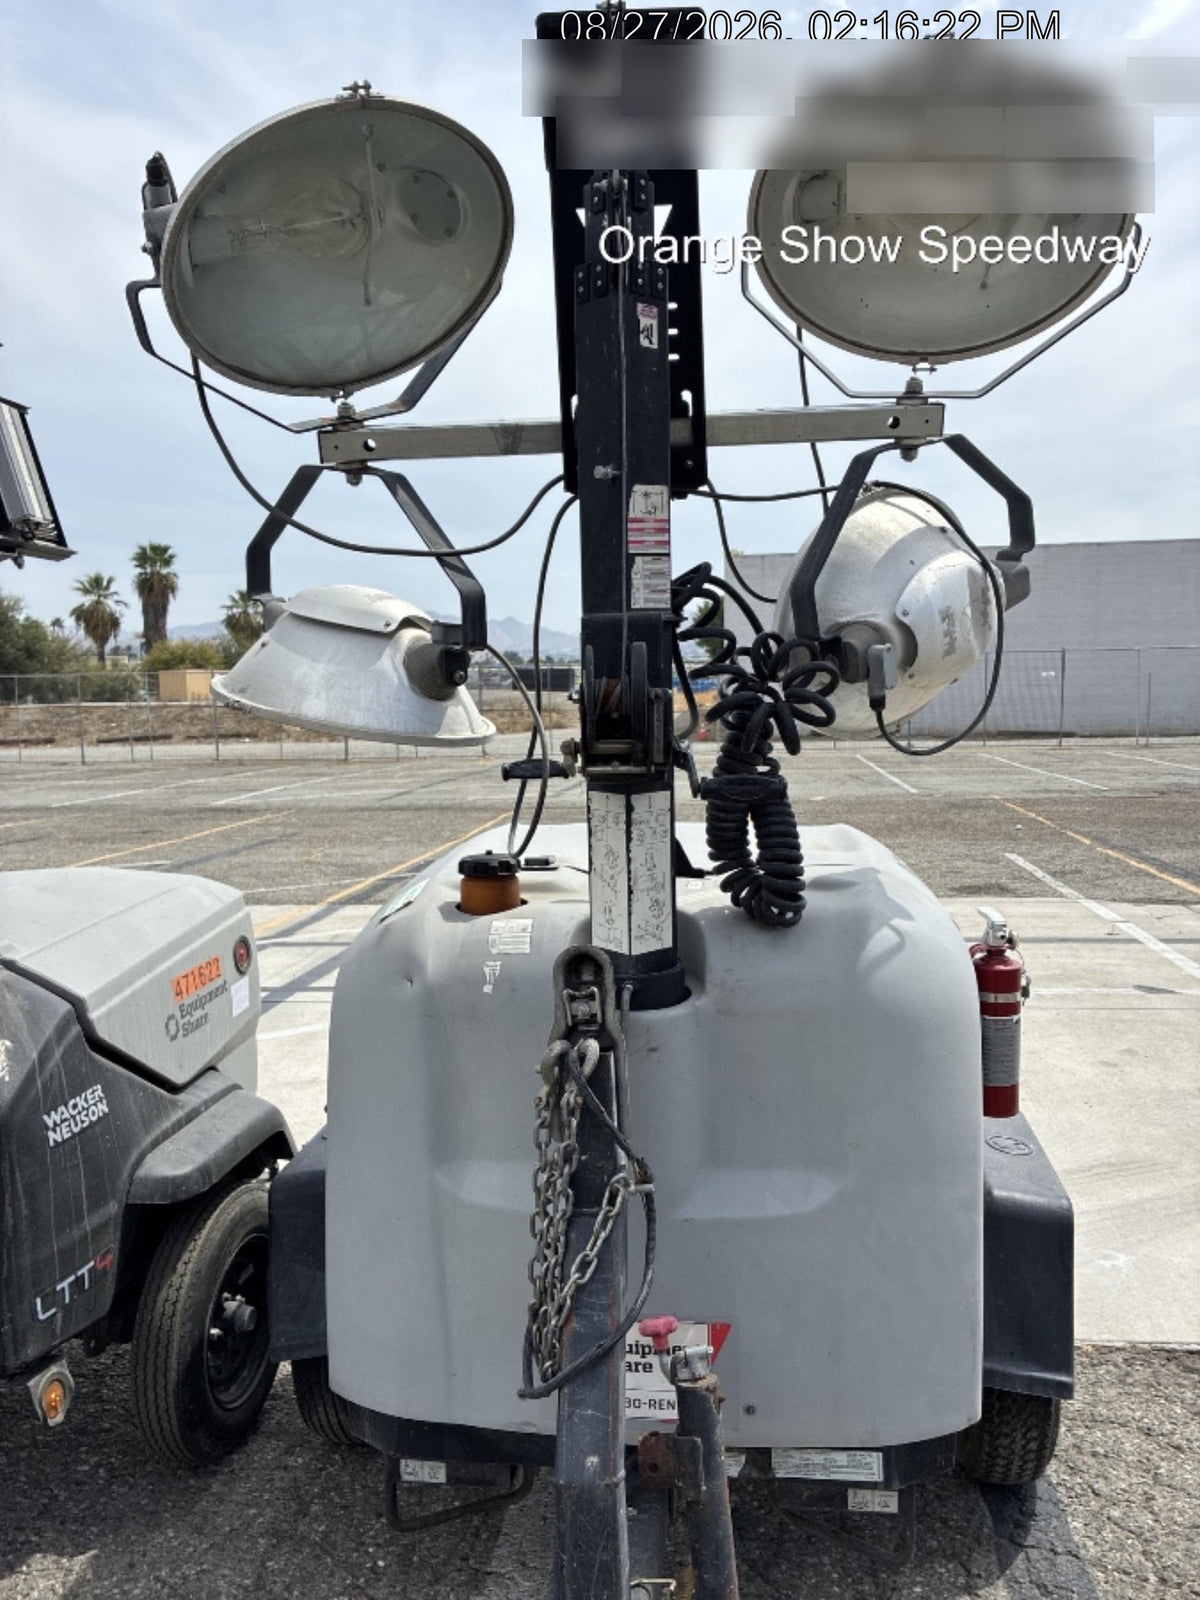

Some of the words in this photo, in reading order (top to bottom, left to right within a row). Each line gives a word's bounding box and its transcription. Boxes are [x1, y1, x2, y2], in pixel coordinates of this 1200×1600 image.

[175, 957, 222, 998] 471622
[179, 980, 228, 1019] Equipment
[181, 1012, 209, 1038] Share
[42, 1084, 105, 1128] WACKER
[47, 1098, 109, 1147] NEUSON
